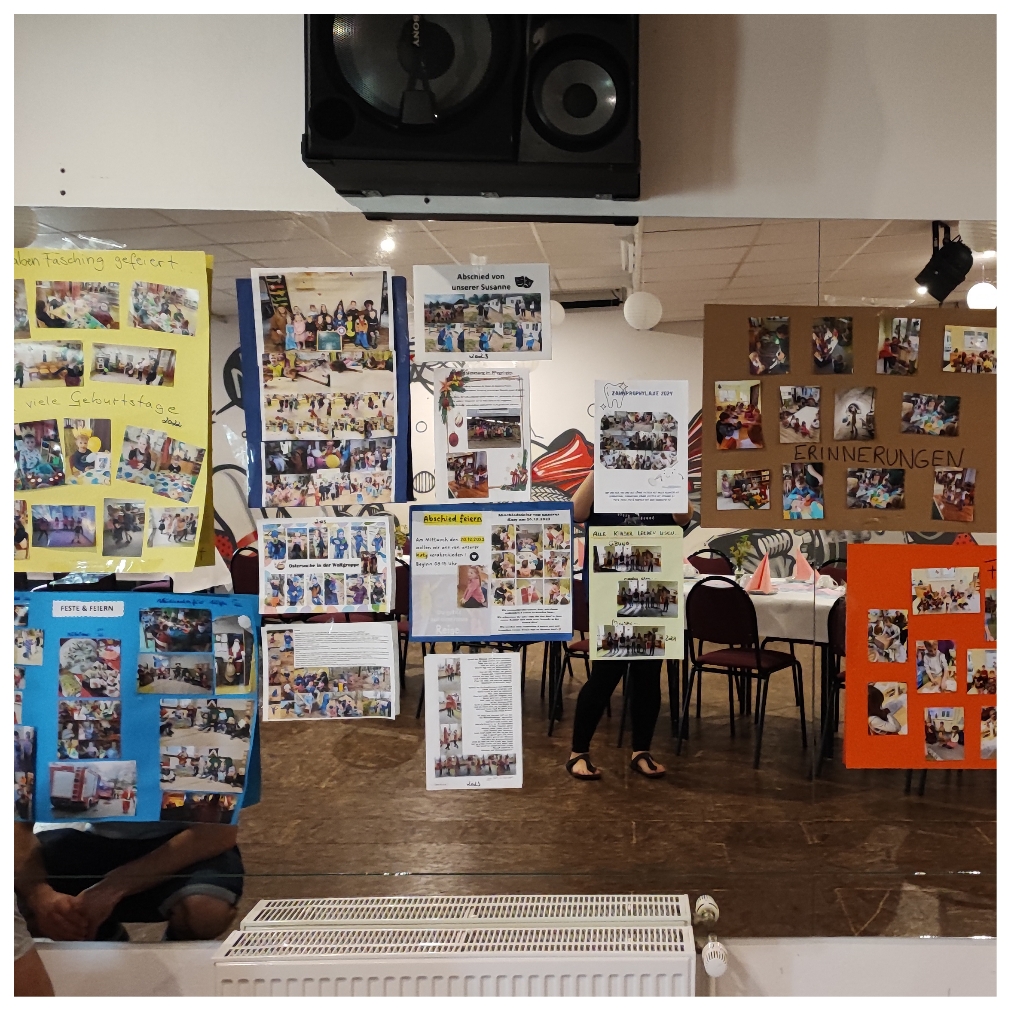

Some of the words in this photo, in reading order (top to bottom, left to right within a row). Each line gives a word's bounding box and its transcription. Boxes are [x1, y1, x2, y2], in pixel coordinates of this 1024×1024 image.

[43, 252, 105, 271] Fasching
[457, 273, 490, 281] Abschied
[26, 395, 61, 409] viele
[69, 390, 180, 415] Geburtstage
[794, 443, 965, 470] ERINNERUNGEN
[423, 514, 456, 523] Abschied
[459, 513, 483, 523] feiern
